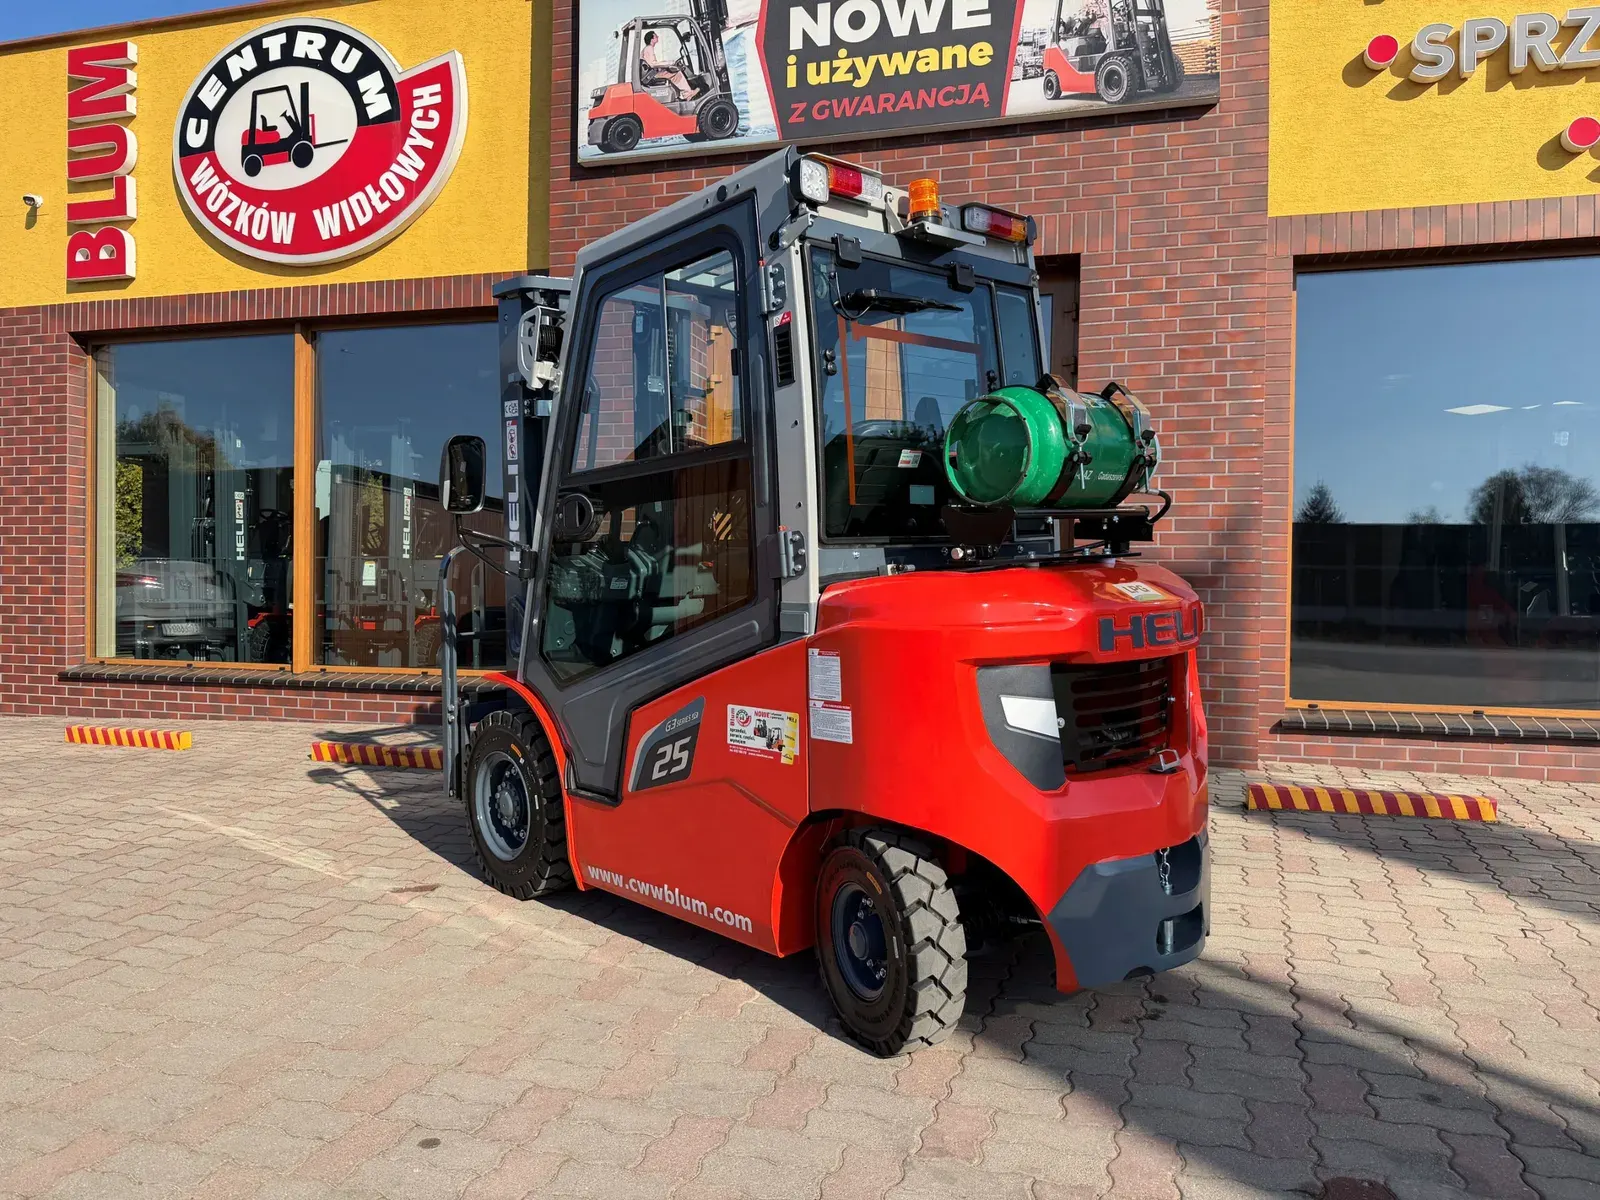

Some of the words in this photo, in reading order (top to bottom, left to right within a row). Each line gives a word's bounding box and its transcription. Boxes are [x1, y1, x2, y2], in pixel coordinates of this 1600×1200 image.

[790, 0, 992, 50] NOWE
[786, 54, 797, 88] i
[806, 41, 994, 88] używane
[186, 30, 392, 148] CENTRUM
[811, 82, 990, 121] GWARANCJĄ
[67, 41, 136, 282] BLUM
[189, 157, 296, 245] WÓZKÓW
[312, 82, 442, 241] WIDŁOWYCH
[507, 464, 521, 561] HELI
[235, 519, 245, 560] HELI
[402, 515, 411, 559] HELI
[1122, 584, 1150, 594] LPG
[665, 718, 677, 732] G3
[652, 736, 691, 780] 25
[588, 865, 752, 933] www.cwwblum.com
